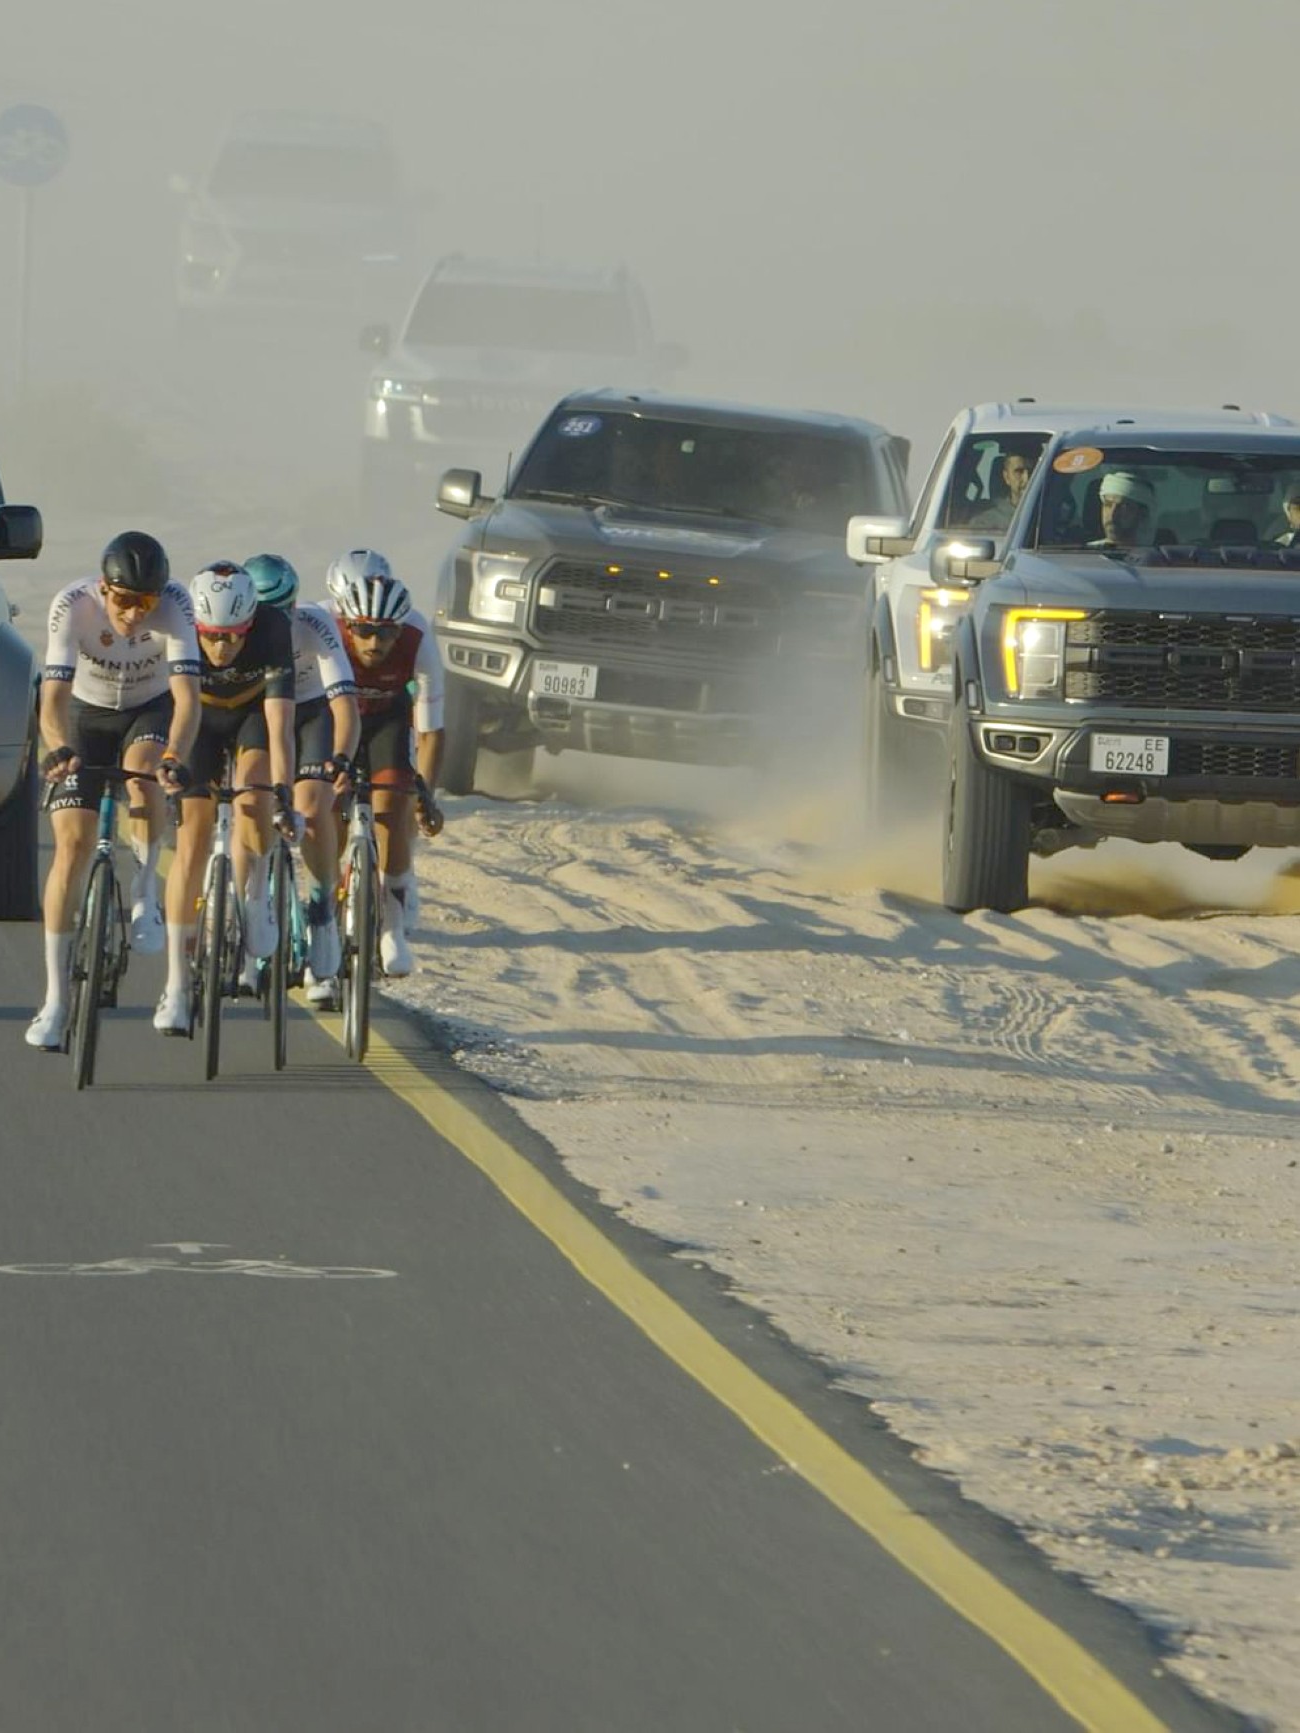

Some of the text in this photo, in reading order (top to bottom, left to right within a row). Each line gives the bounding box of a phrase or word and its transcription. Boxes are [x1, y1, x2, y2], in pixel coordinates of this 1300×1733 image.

[50, 584, 88, 633] OMNIYAT
[299, 611, 339, 649] OMNIYAT
[79, 651, 162, 671] OMNIYAT
[544, 674, 585, 695] 90983
[1145, 738, 1164, 751] EE
[1105, 751, 1155, 772] 62248
